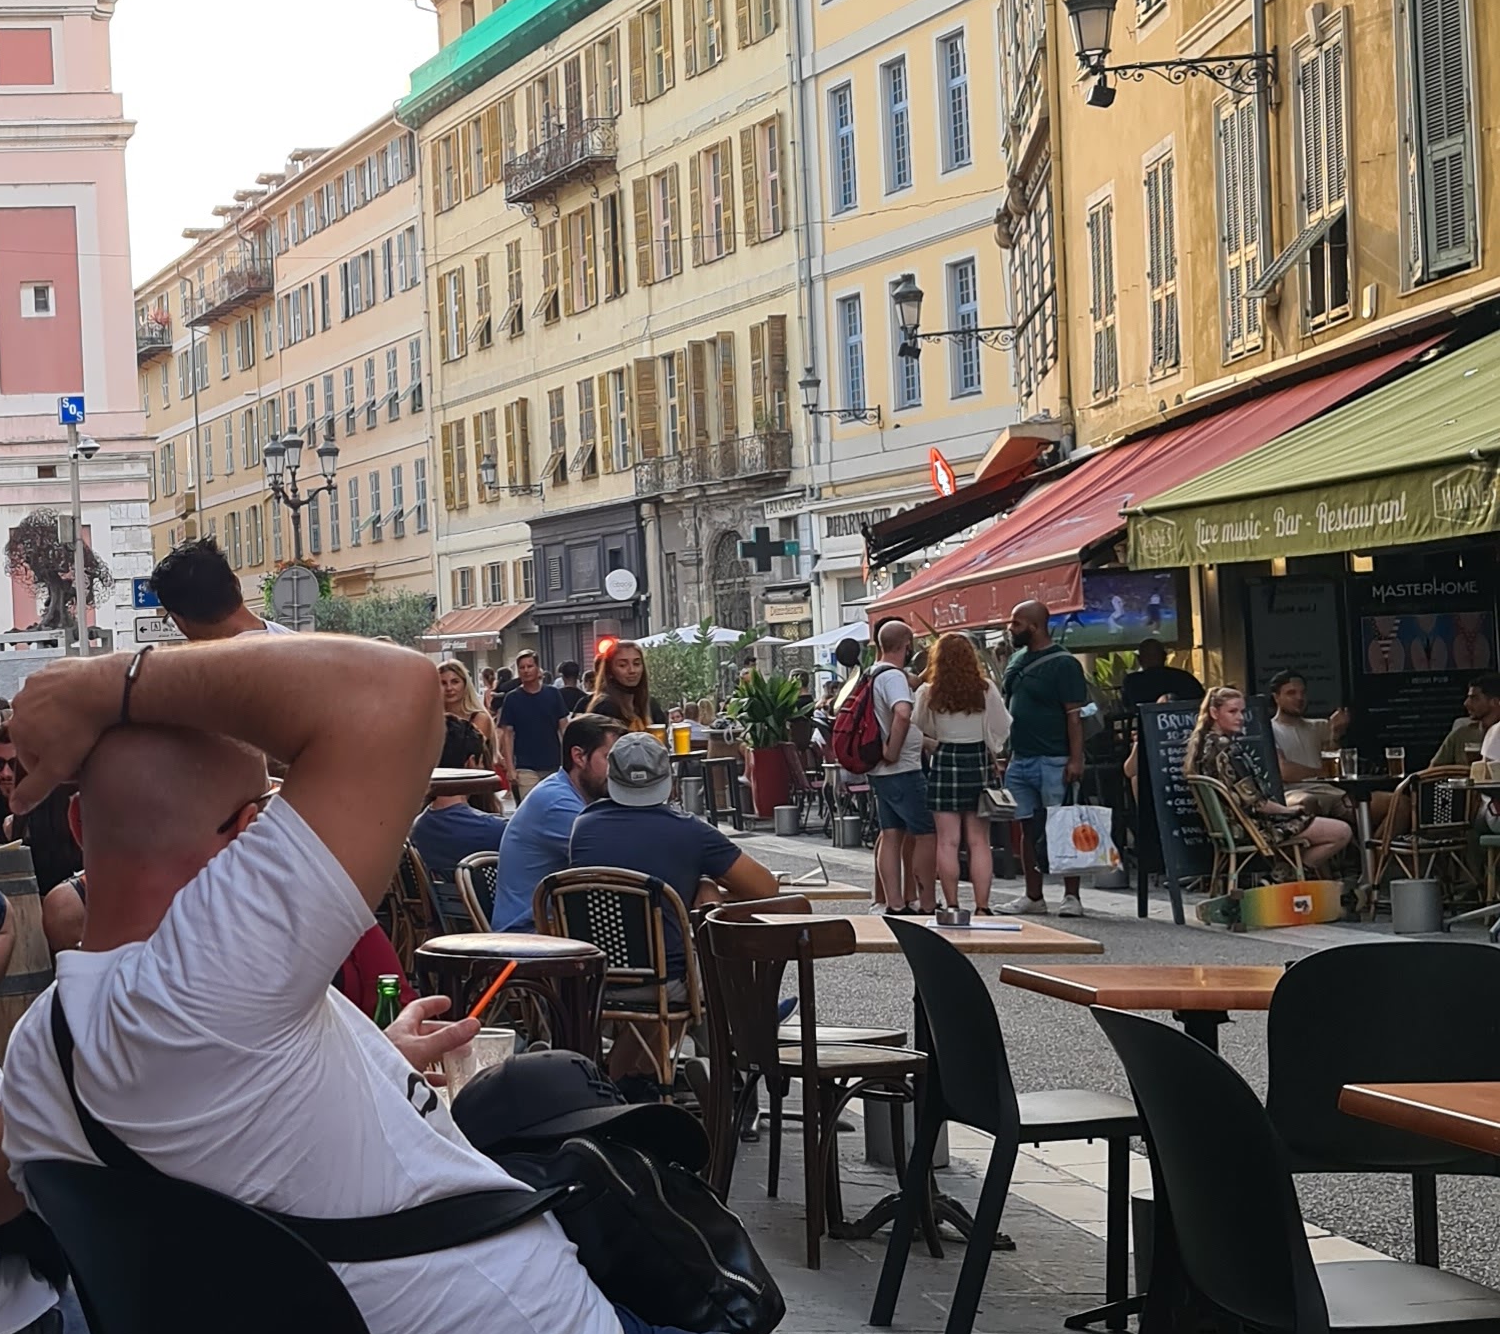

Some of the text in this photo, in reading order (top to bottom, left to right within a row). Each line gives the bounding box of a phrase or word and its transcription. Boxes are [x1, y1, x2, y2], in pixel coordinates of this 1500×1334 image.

[62, 397, 84, 422] SOS
[1195, 517, 1219, 553] Live
[1222, 515, 1261, 543] music
[1273, 506, 1303, 537] Bar
[1315, 491, 1408, 534] Restaurant
[1371, 574, 1478, 603] MASTERHOME
